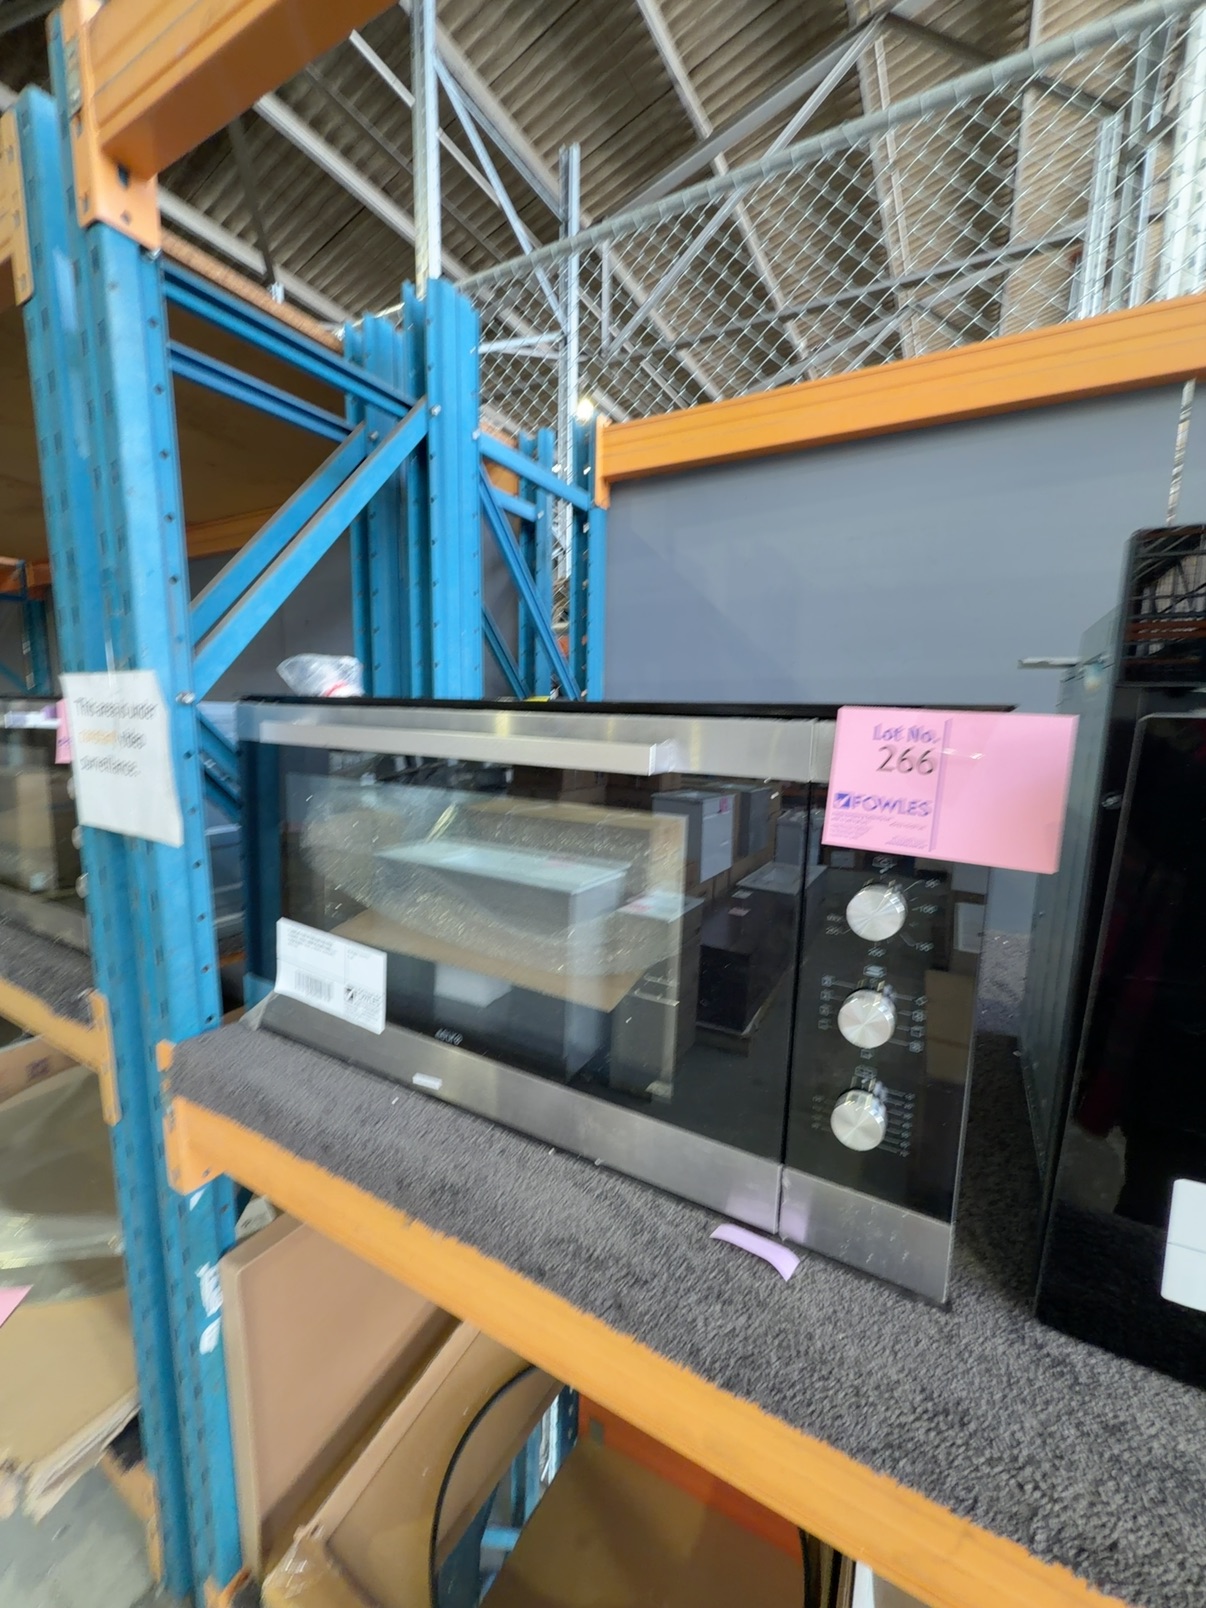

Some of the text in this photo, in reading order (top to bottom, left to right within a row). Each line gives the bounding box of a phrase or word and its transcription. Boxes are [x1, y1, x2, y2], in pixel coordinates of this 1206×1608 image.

[872, 724, 941, 744] Lot No.
[876, 745, 936, 776] 266
[850, 795, 932, 817] FOWLES
